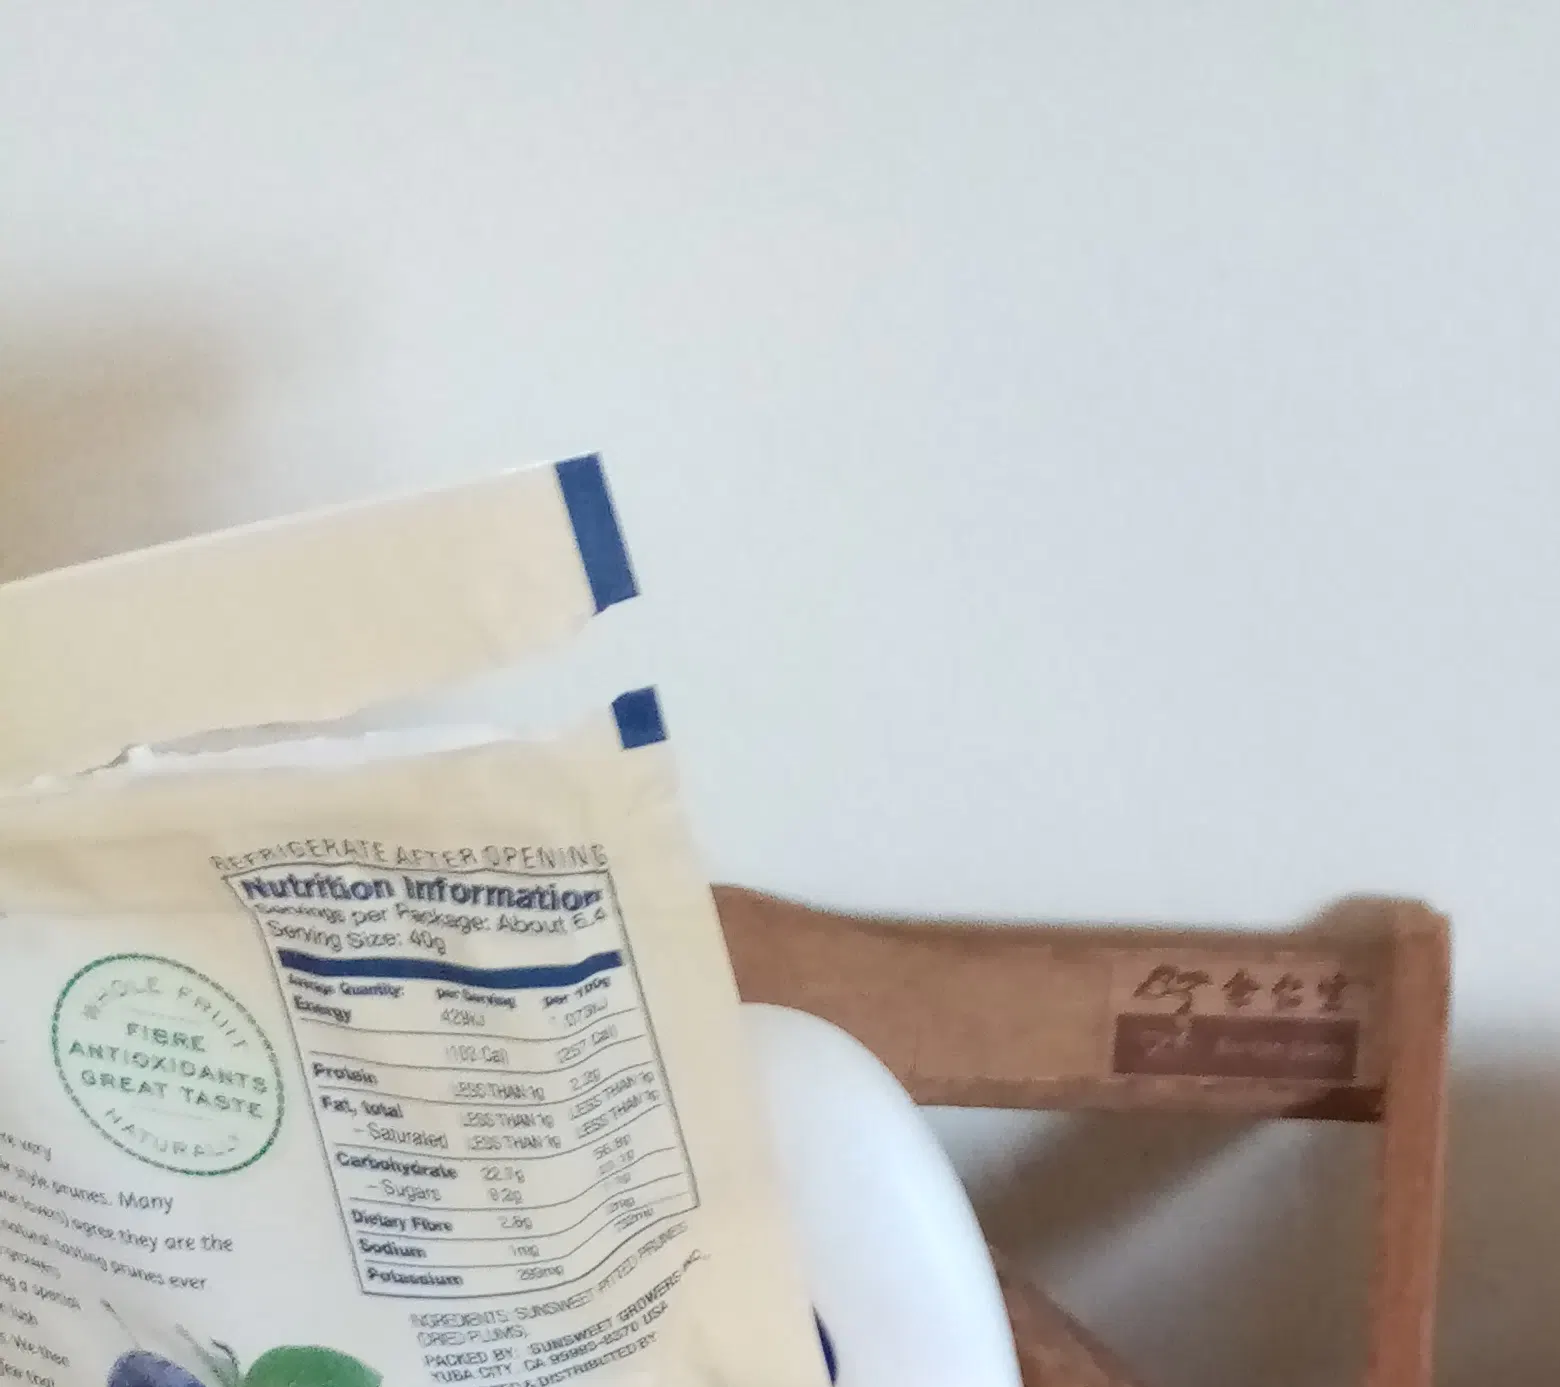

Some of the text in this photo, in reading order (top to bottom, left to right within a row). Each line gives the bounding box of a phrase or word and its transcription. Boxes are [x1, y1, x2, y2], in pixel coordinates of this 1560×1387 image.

[396, 846, 478, 869] AFTER
[483, 845, 608, 869] OPENING
[240, 872, 602, 911] Nutrition Information
[351, 907, 388, 926] per
[497, 912, 567, 935] About
[266, 919, 447, 955] Serving Size: 40g
[126, 1021, 206, 1053] FIBRE
[312, 1061, 379, 1086] Protein
[80, 1068, 264, 1121] GREAT TASTE
[336, 1150, 459, 1180] Carbohydrate
[117, 1190, 174, 1215] Many
[381, 1178, 443, 1202] Sugars
[350, 1208, 406, 1232] Dietary
[163, 1234, 197, 1252] are
[199, 1232, 235, 1253] the
[358, 1237, 428, 1258] Sodium
[423, 1350, 489, 1368] PACKED
[527, 1316, 614, 1356] SUNSWEET
[616, 1269, 683, 1324] GROWERS
[537, 1343, 638, 1387] DISTRIBUTED
